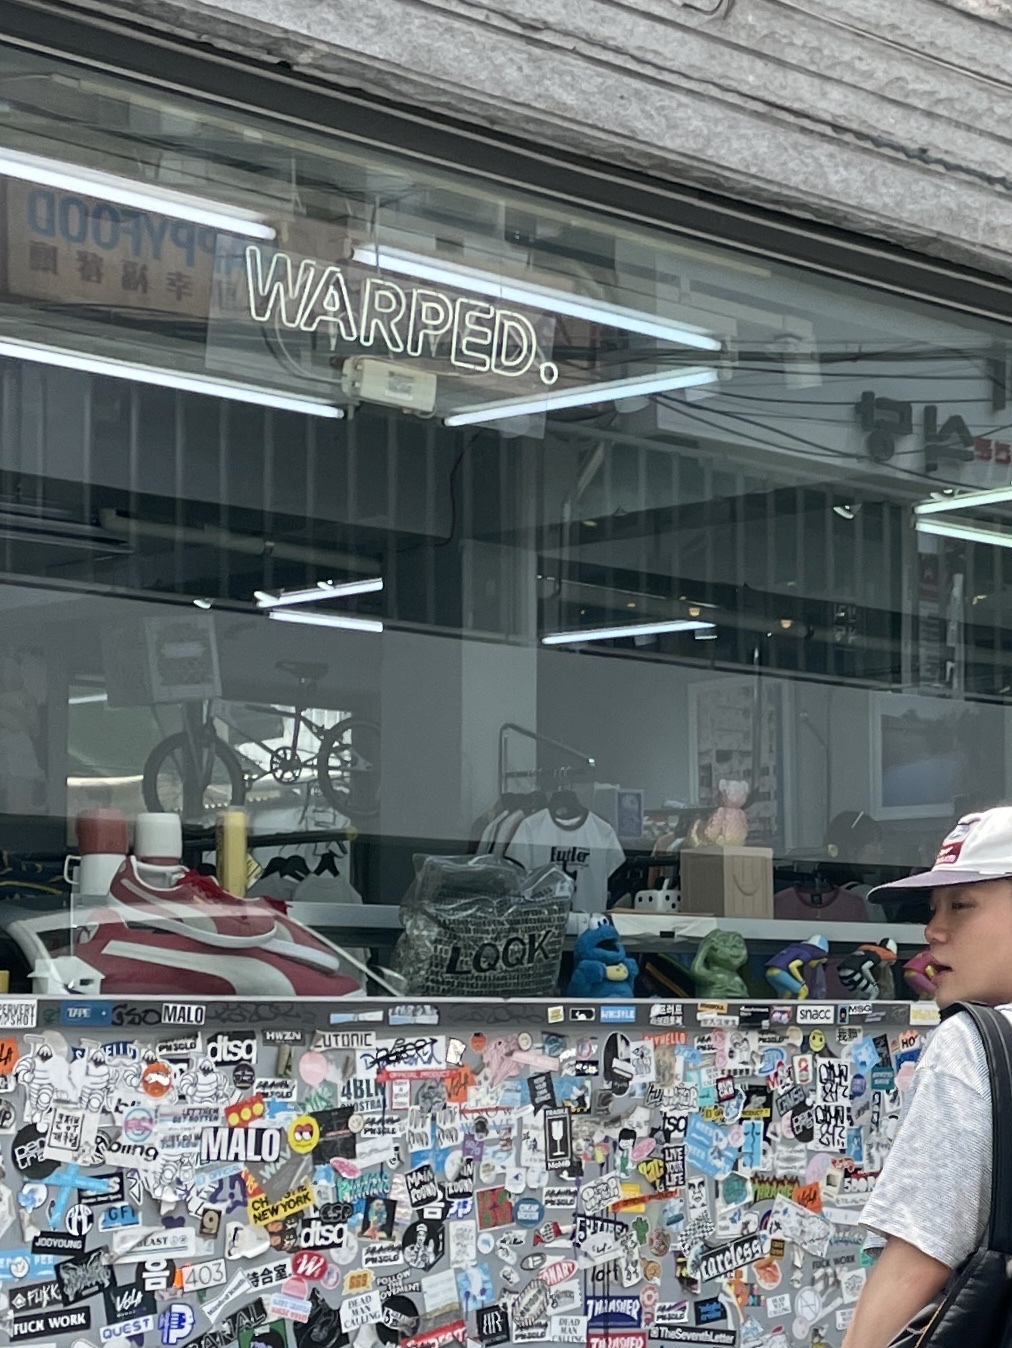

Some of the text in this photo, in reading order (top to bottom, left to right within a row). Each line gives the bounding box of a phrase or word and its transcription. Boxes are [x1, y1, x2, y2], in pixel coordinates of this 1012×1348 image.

[246, 245, 559, 385] WARPED.
[163, 1005, 204, 1024] MALO
[201, 1127, 281, 1162] MALO
[184, 1261, 224, 1287] 403
[348, 1294, 373, 1309] DEAD
[49, 1312, 86, 1330] WORK
[102, 1318, 151, 1340] QUEST
